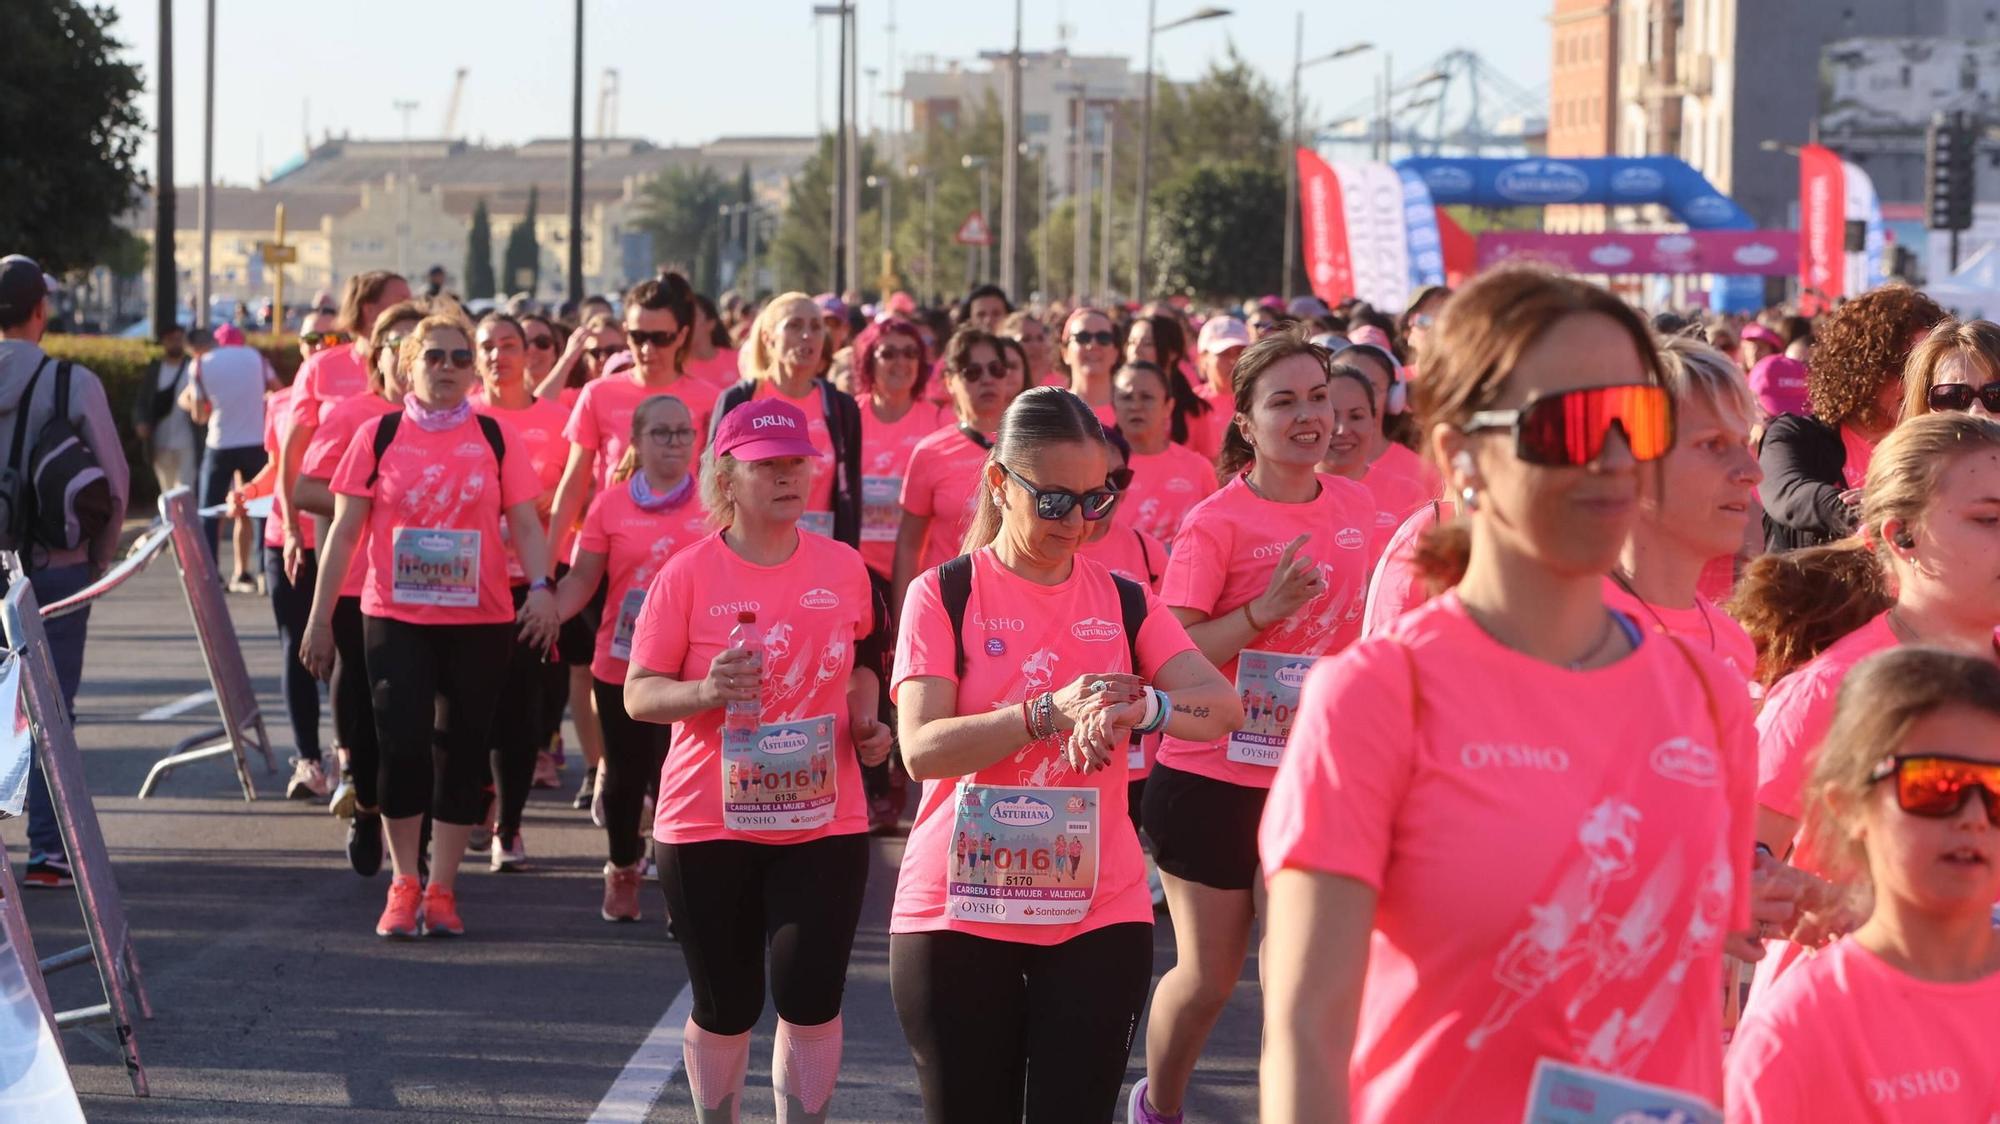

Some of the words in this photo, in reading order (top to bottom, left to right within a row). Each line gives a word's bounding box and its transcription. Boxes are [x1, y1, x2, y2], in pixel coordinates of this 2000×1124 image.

[752, 414, 796, 430] DRUNI
[710, 600, 760, 617] OYSHO
[1237, 734, 1267, 745] CARRERA
[1268, 736, 1277, 745] DE
[1277, 738, 1286, 746] LA
[1242, 747, 1279, 760] OYSHO
[1460, 743, 1569, 773] OYSHO
[764, 769, 810, 790] 016
[775, 793, 798, 802] 6136
[763, 803, 771, 811] DE
[773, 803, 781, 811] LA
[783, 801, 806, 810] MUJER
[994, 805, 1049, 819] ASTURIANA
[737, 815, 777, 825] OYSHO
[994, 847, 1050, 871] 016
[1006, 876, 1033, 886] 5170
[956, 886, 988, 896] CARRERA
[990, 889, 1000, 897] DE
[1002, 889, 1013, 897] LA
[1014, 889, 1042, 898] MUJER
[1049, 890, 1086, 899] VALENCIA
[962, 901, 1006, 915] OYSHO
[1035, 907, 1077, 916] Santander
